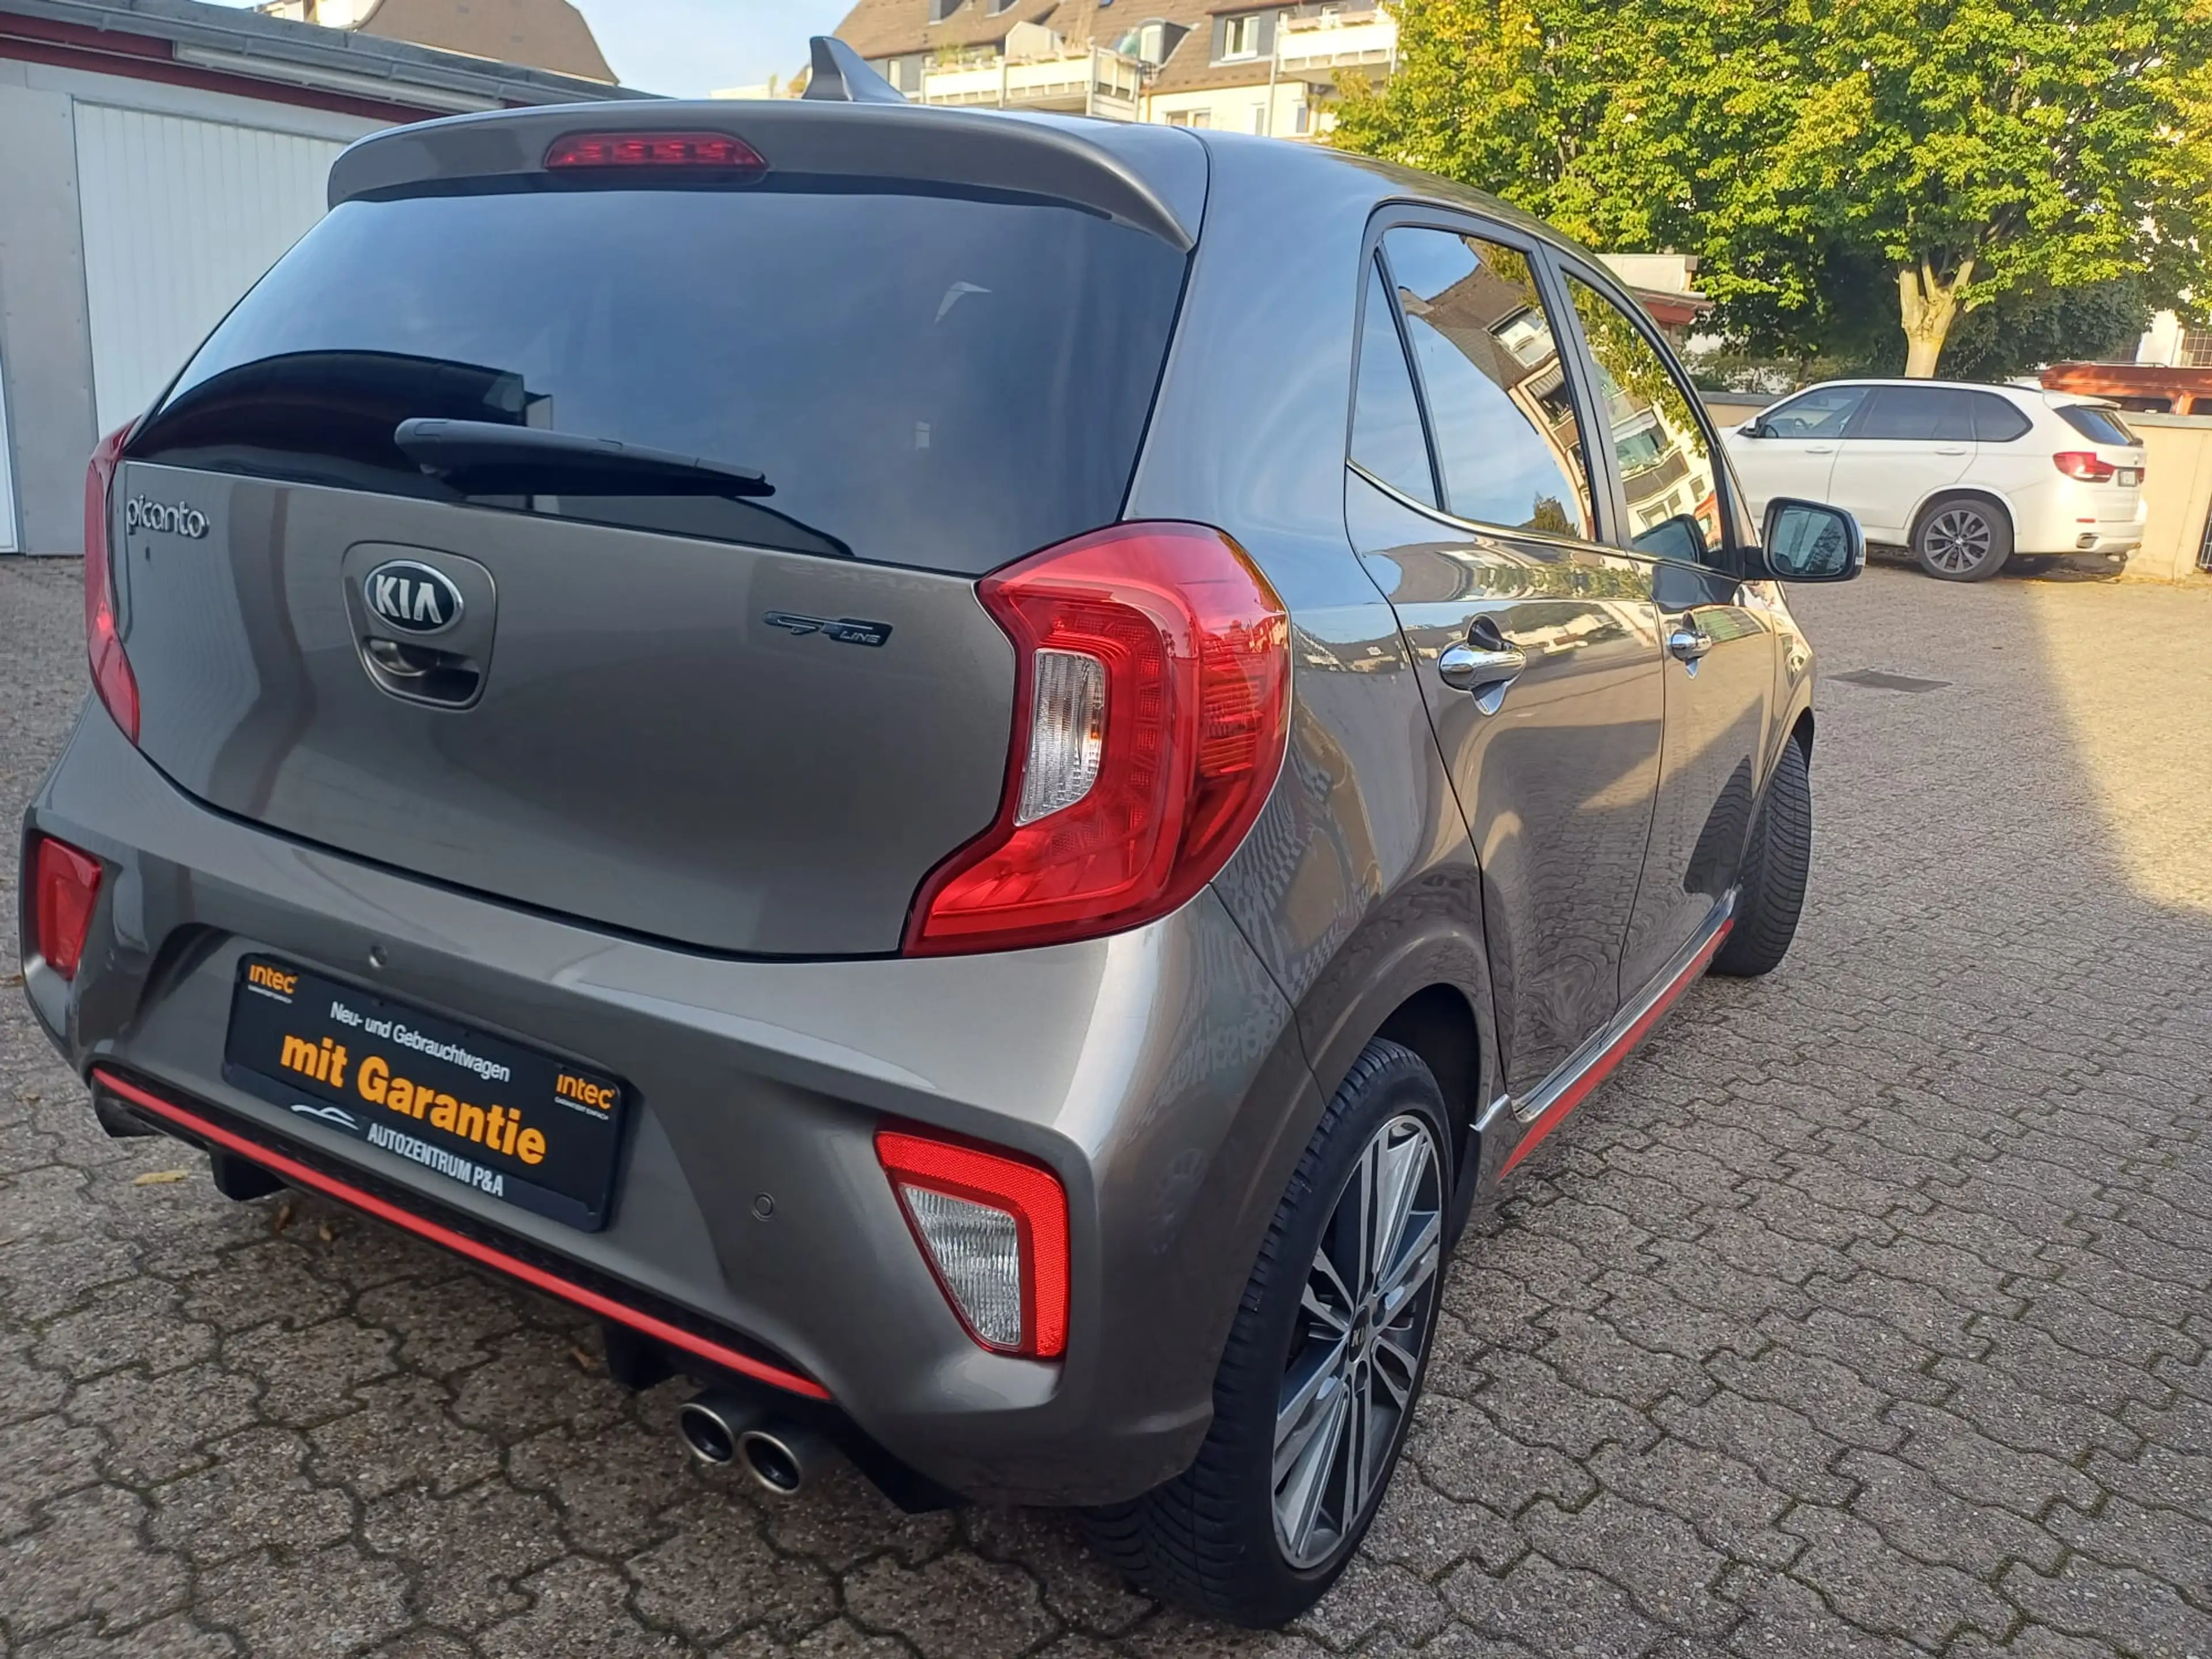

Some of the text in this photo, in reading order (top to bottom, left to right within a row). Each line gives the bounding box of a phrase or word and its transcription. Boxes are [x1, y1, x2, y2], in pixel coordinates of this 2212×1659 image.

[127, 495, 210, 538] picanto
[376, 574, 443, 624] KIA
[839, 631, 881, 644] LINE
[249, 964, 295, 994] intec
[330, 1001, 510, 1082] Neu- und Gebrauchtwagen
[281, 1035, 546, 1165] mit Garantie
[556, 1074, 613, 1109] intec
[367, 1123, 503, 1197] AUTOZENTRUM P&A
